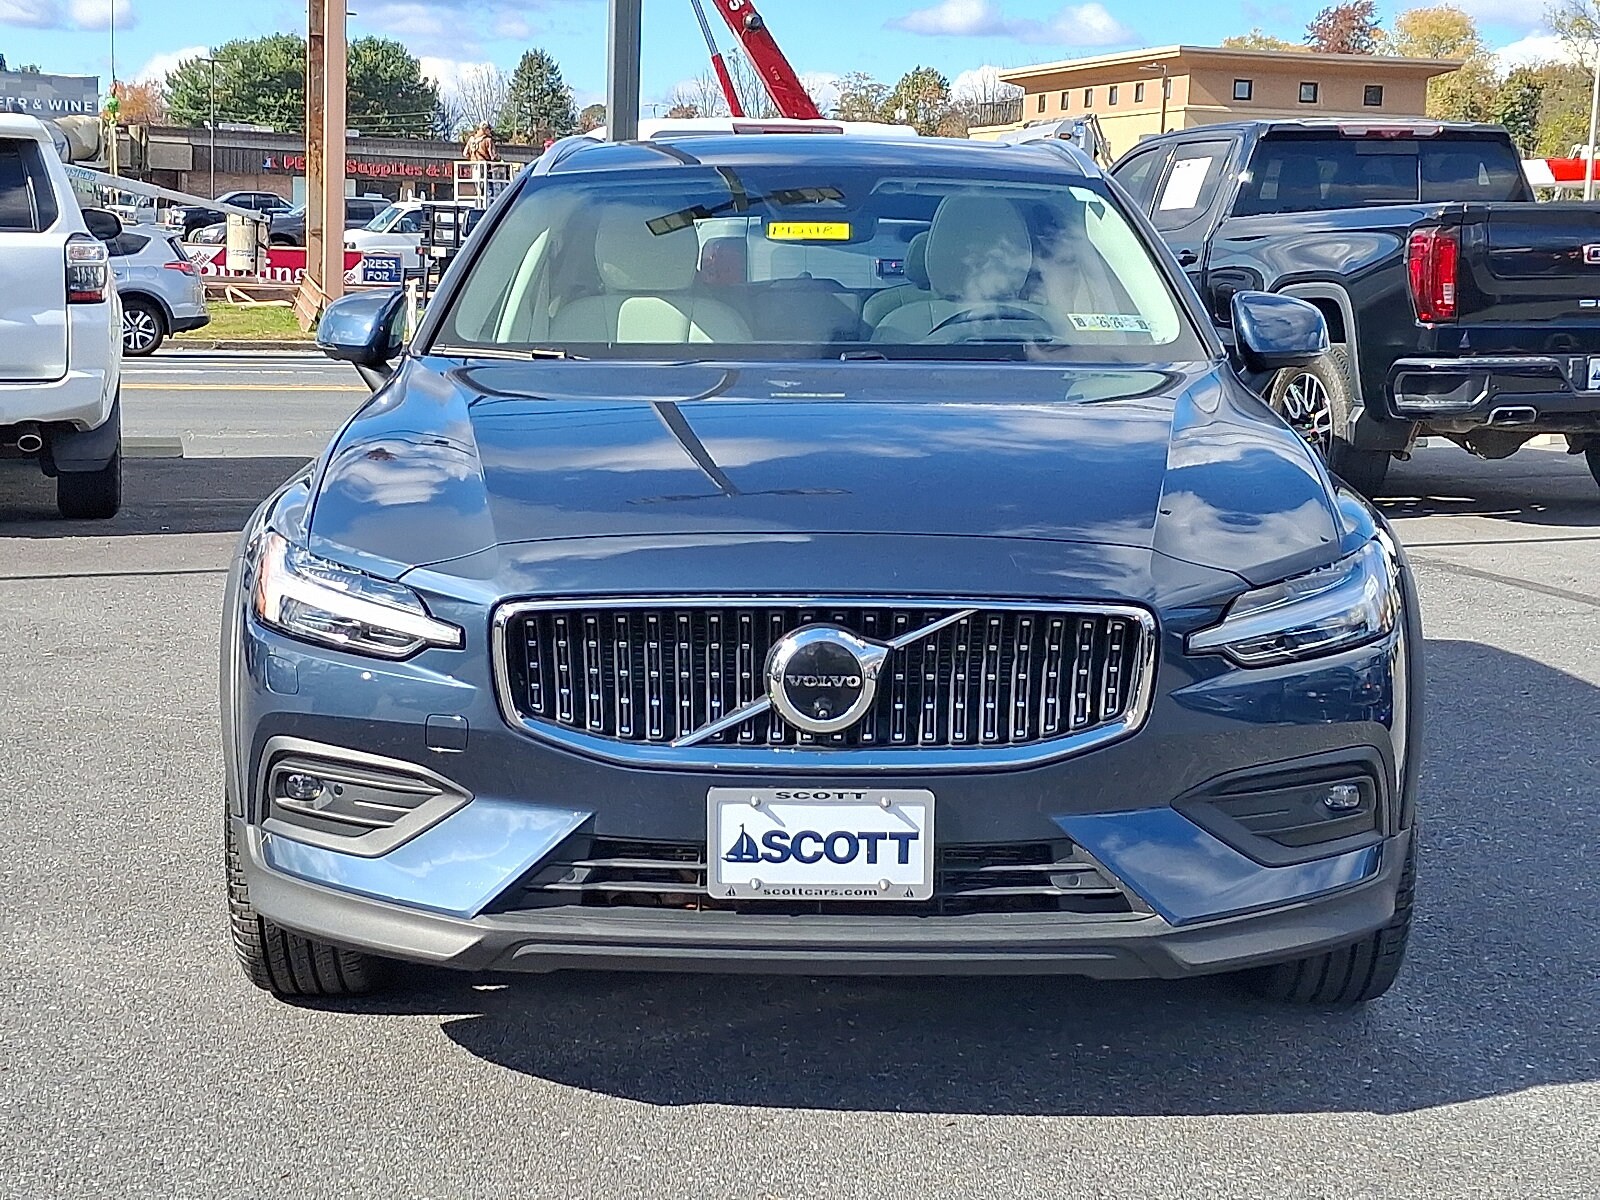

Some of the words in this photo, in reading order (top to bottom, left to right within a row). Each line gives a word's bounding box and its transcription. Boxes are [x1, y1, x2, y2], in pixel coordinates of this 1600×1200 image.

[32, 97, 42, 110] &
[48, 99, 93, 112] WINE
[283, 155, 305, 170] PE
[346, 159, 423, 178] Supplies
[426, 164, 440, 177] &
[367, 270, 390, 281] FOR
[785, 675, 861, 687] VOLVO
[775, 791, 868, 800] SCOTT
[761, 829, 920, 865] SCOTT
[763, 887, 878, 897] scottcars.com
